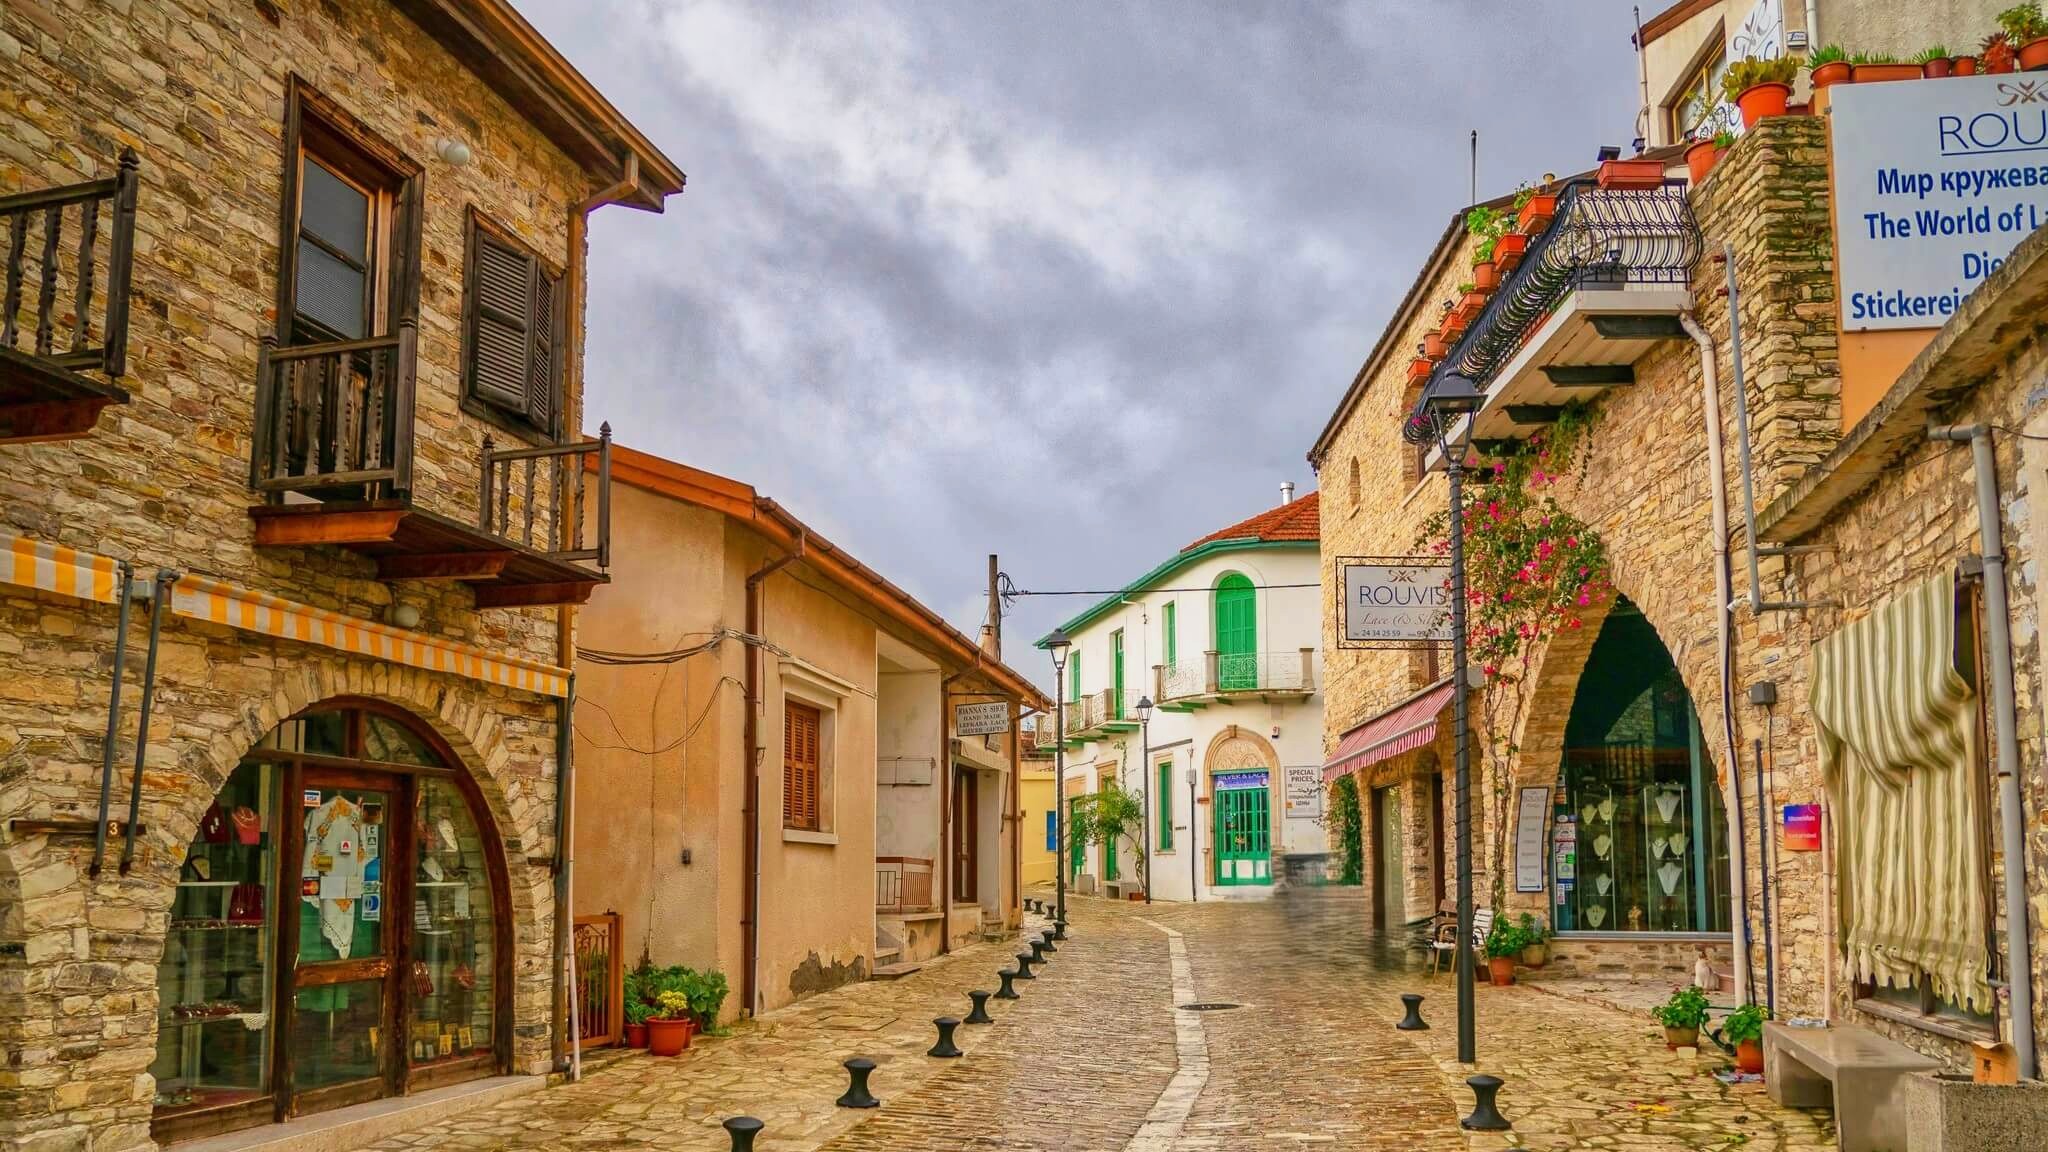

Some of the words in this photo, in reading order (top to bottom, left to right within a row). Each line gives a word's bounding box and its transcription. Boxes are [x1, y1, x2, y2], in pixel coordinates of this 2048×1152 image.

[1939, 110, 2048, 151] ROU
[1878, 168, 1934, 200] Мир
[1941, 165, 2048, 197] кружева
[1864, 212, 1911, 239] The
[1915, 205, 1990, 237] World
[1998, 203, 2024, 232] of
[2030, 204, 2048, 231] L
[1852, 287, 1970, 320] Stickerei
[1359, 585, 1447, 606] ROUVIS
[990, 704, 1006, 712] SHOP
[109, 822, 118, 835] 3
